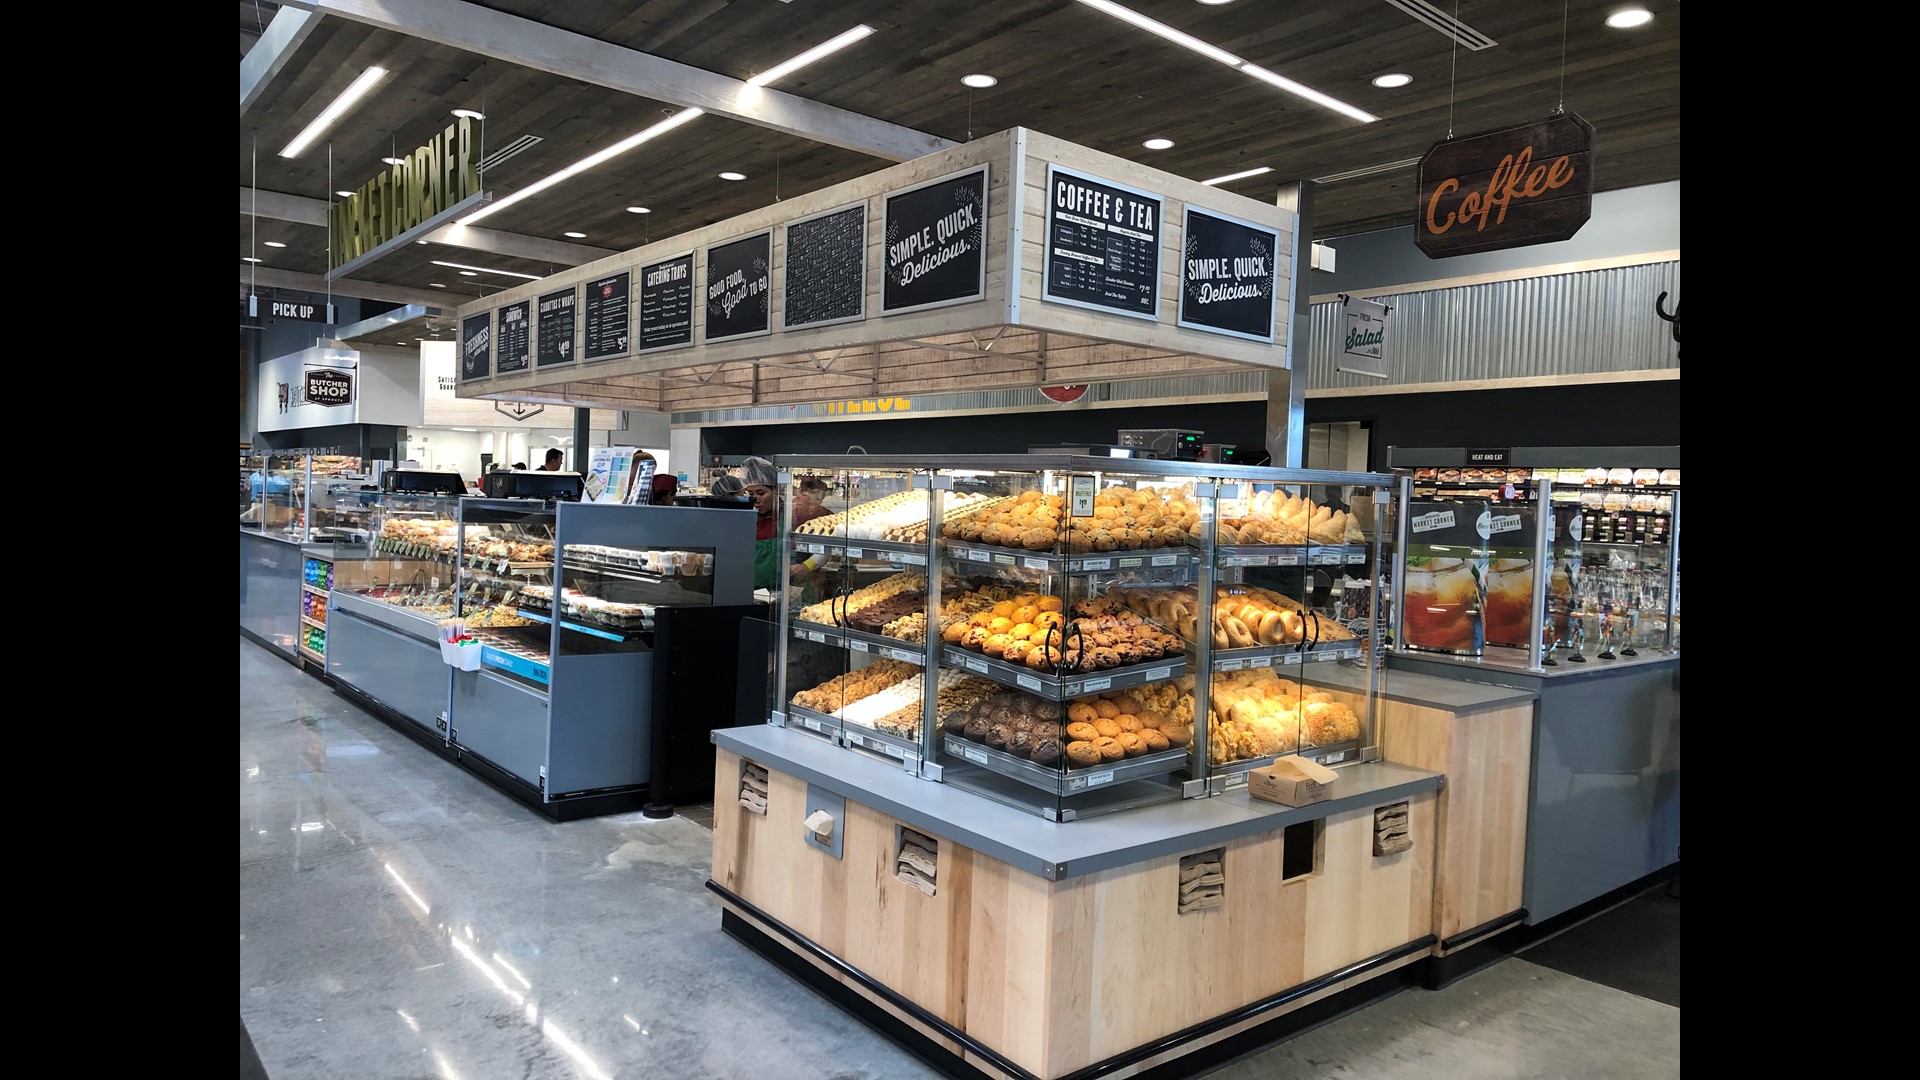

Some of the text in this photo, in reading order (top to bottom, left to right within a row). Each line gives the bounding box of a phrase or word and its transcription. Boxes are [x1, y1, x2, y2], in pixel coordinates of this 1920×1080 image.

[392, 116, 472, 237] CORNER
[1427, 145, 1575, 235] Coffee
[1057, 181, 1153, 231] COFFEE & TEA
[890, 203, 978, 267] SIMPLE. QUICK.
[900, 238, 971, 287] Delicious.
[1188, 257, 1268, 281] SIMPLE. QUICK.
[647, 268, 670, 287] CATERING
[671, 263, 687, 281] TRAYS
[561, 294, 575, 308] WRAPS
[709, 279, 725, 300] GOOD
[721, 275, 768, 319] Good TO GO
[1198, 282, 1262, 304] Delicious.
[272, 302, 314, 319] PICK UP
[1345, 327, 1384, 350] Salad
[310, 379, 348, 388] BUTCHER
[310, 385, 348, 397] SHOP
[1413, 516, 1454, 528] MARKET CORNER
[1500, 519, 1520, 527] CORNER
